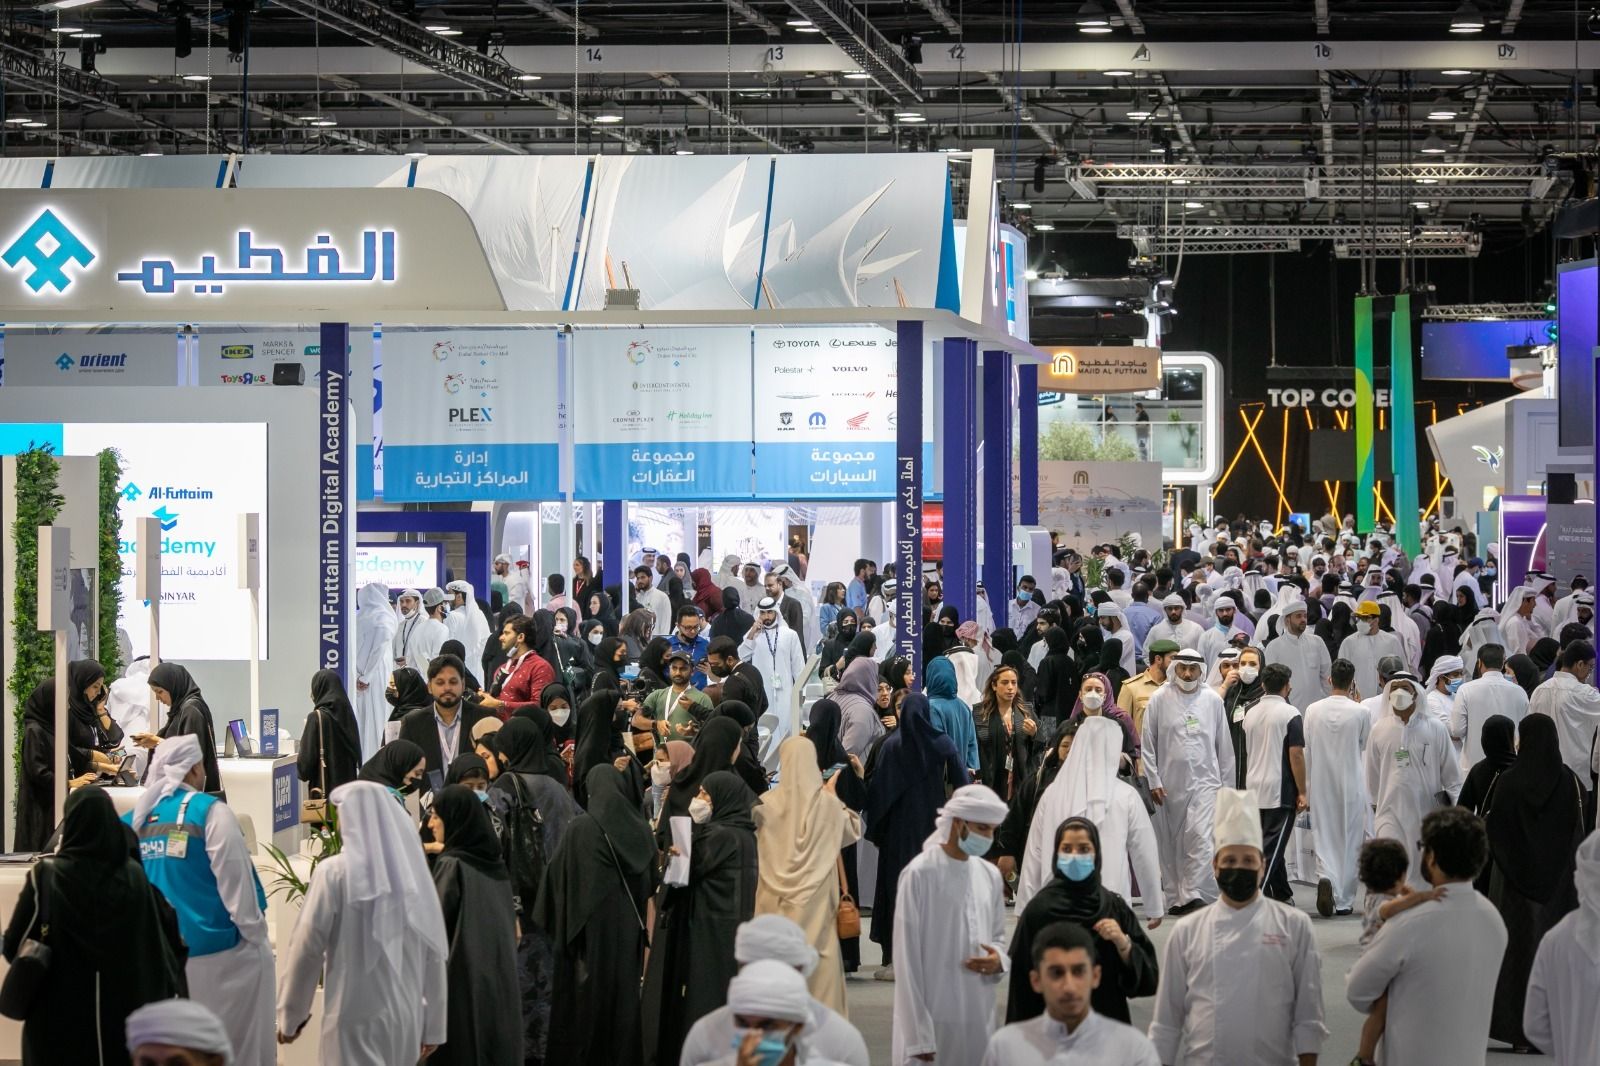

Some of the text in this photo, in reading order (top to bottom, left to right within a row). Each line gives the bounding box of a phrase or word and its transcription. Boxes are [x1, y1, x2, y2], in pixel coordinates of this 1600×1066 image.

[586, 48, 602, 61] 14
[767, 47, 784, 60] 13
[118, 231, 395, 293] الفطيم
[787, 340, 820, 348] TOYOTA
[885, 338, 897, 347] Je
[80, 352, 127, 367] orient
[774, 366, 803, 374] Polestar
[1267, 388, 1392, 408] TOP COE
[449, 407, 493, 422] PLEX
[454, 450, 488, 466] إدارة
[631, 448, 695, 465] مجموعة
[811, 448, 875, 464] مجموعة
[415, 471, 529, 488] المراكز التجارية
[632, 469, 695, 484] العقارات
[810, 469, 877, 486] السيارات
[148, 486, 213, 500] Al-Futtaim
[901, 486, 918, 509] بكم
[322, 370, 344, 671] to Al-Futtaim Digital Academy
[902, 512, 919, 537] في
[118, 537, 216, 558] acdemy
[186, 563, 227, 578] أكاديمية
[356, 555, 424, 576] ademy
[898, 540, 917, 587] أكاديمية
[901, 592, 919, 637] الفطيم
